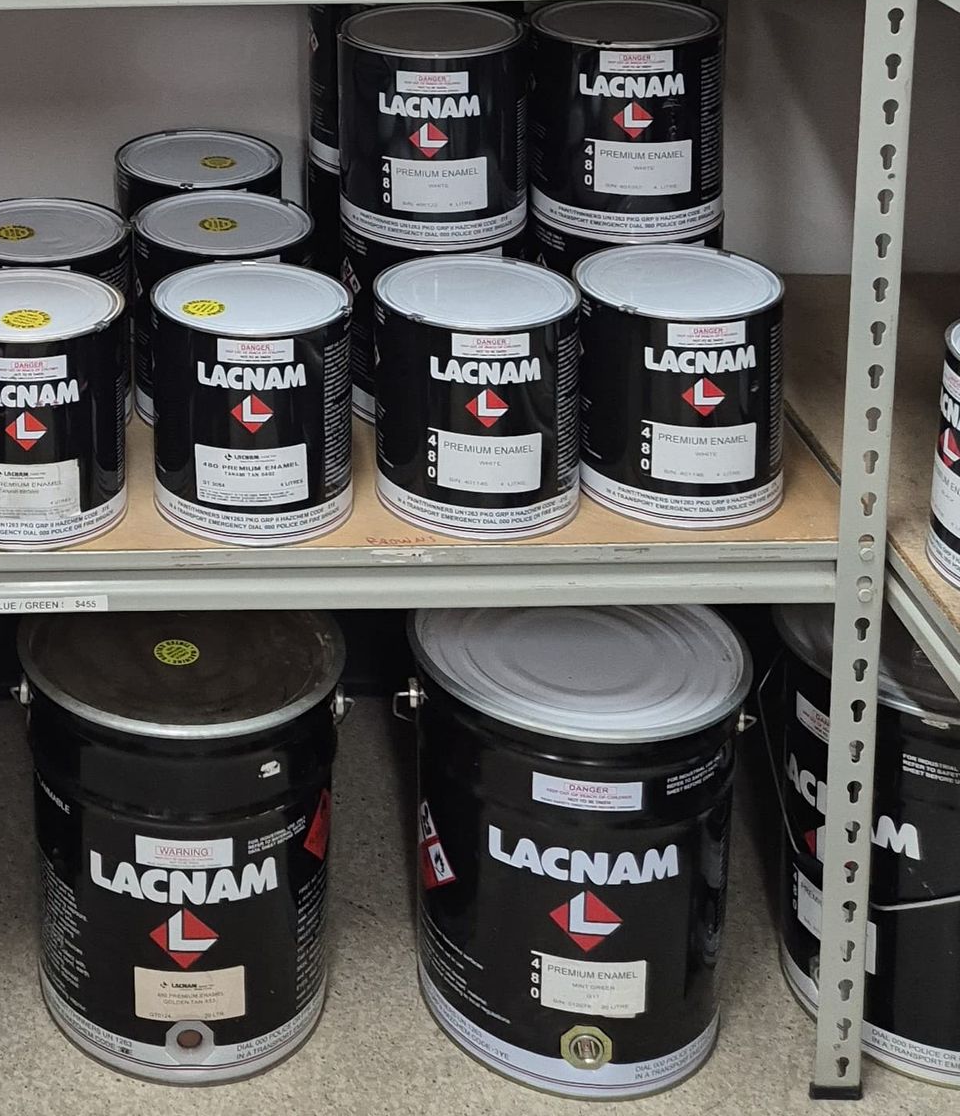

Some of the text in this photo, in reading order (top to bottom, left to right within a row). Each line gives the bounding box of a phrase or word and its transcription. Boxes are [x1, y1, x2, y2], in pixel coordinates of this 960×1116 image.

[579, 73, 685, 98] LACNAM
[379, 92, 480, 119] LACNAM
[600, 150, 685, 160] PREMIUM ENAMEL
[396, 167, 479, 177] PREMIUM ENAMEL
[644, 345, 756, 374] LACNAM
[197, 361, 307, 390] LACNAM
[430, 356, 541, 385] LACNAM
[658, 433, 748, 445] PREMIUM ENAMEL
[444, 441, 534, 455] PREMIUM ENAMEL
[265, 462, 299, 470] ENAMEL
[25, 601, 57, 609] GREEN
[75, 600, 97, 608] $455
[569, 784, 609, 793] DANGER
[159, 846, 209, 857] WARNING
[489, 824, 679, 885] LACNAM
[90, 849, 278, 905] LACNAM
[547, 964, 638, 980] PREMIUM ENAMEL
